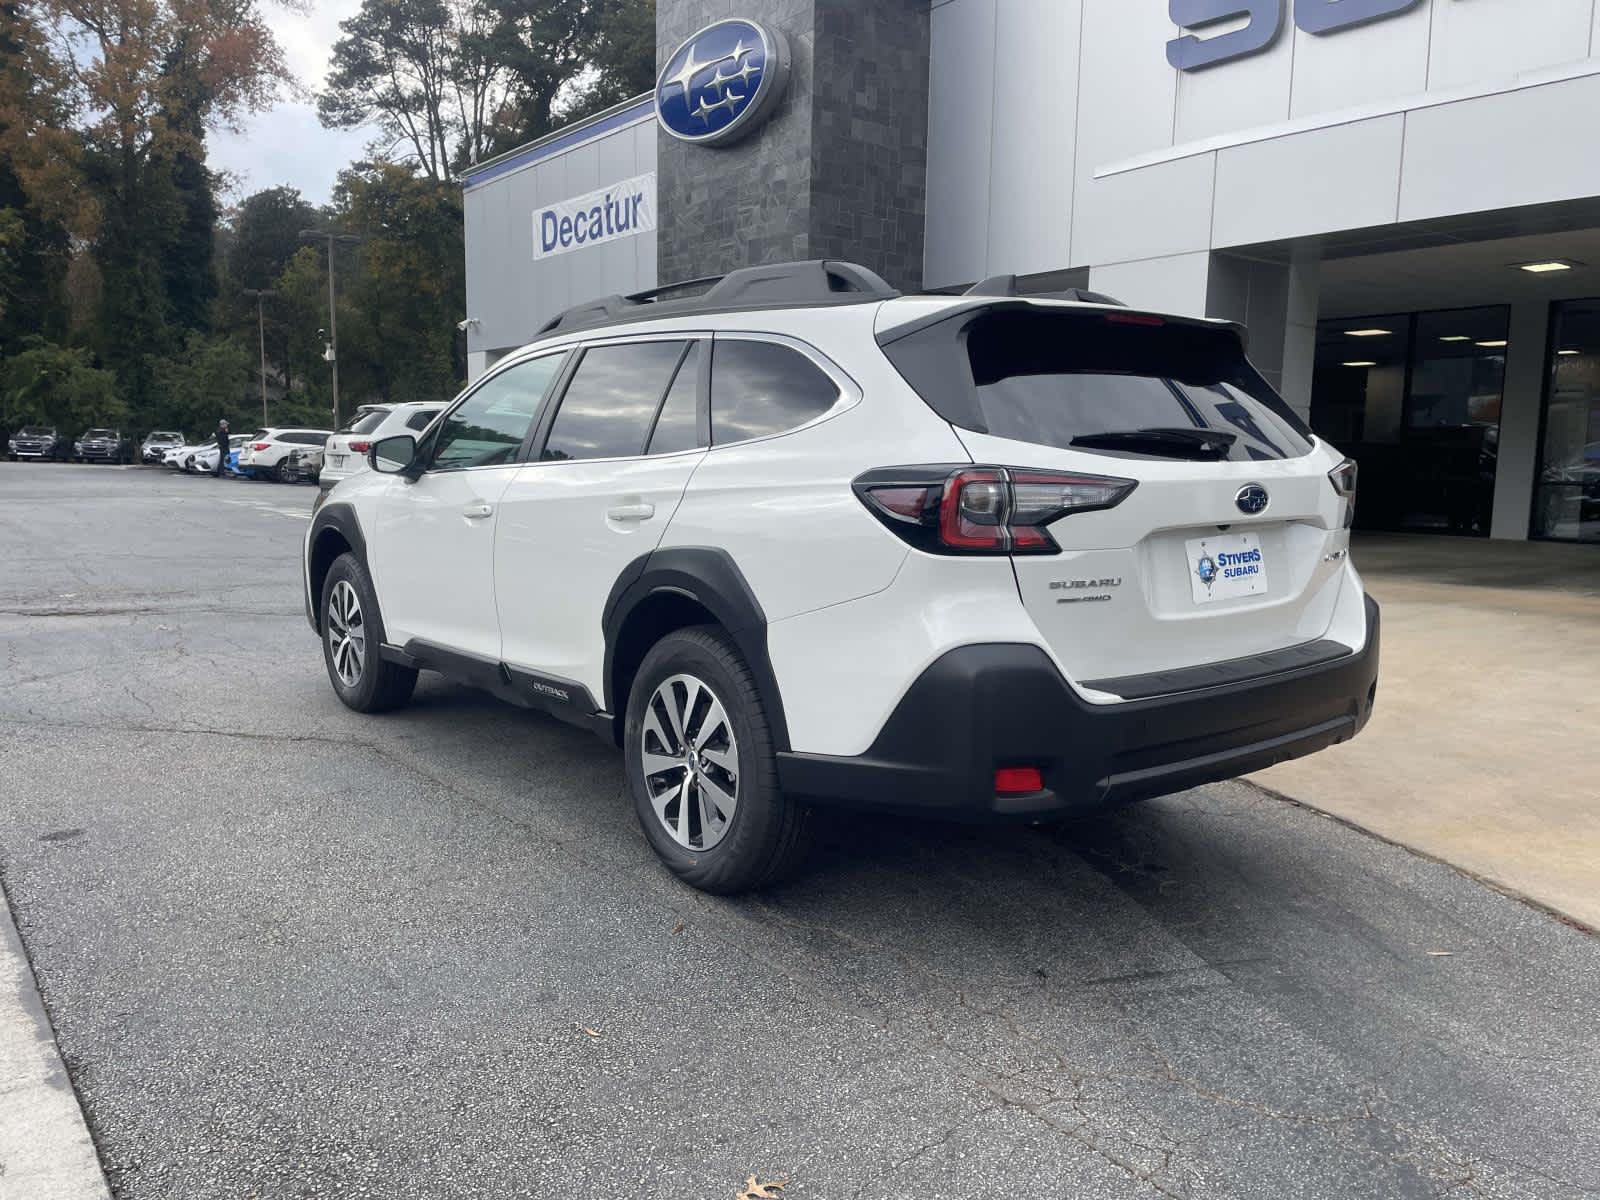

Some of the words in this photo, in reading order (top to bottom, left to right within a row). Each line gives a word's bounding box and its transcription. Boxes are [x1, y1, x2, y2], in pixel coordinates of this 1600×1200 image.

[541, 192, 642, 252] Decatur
[1218, 548, 1261, 567] STIVERS
[1224, 565, 1259, 578] SUBARU
[1049, 577, 1122, 589] SUBARU
[532, 681, 569, 699] OUTBACK
